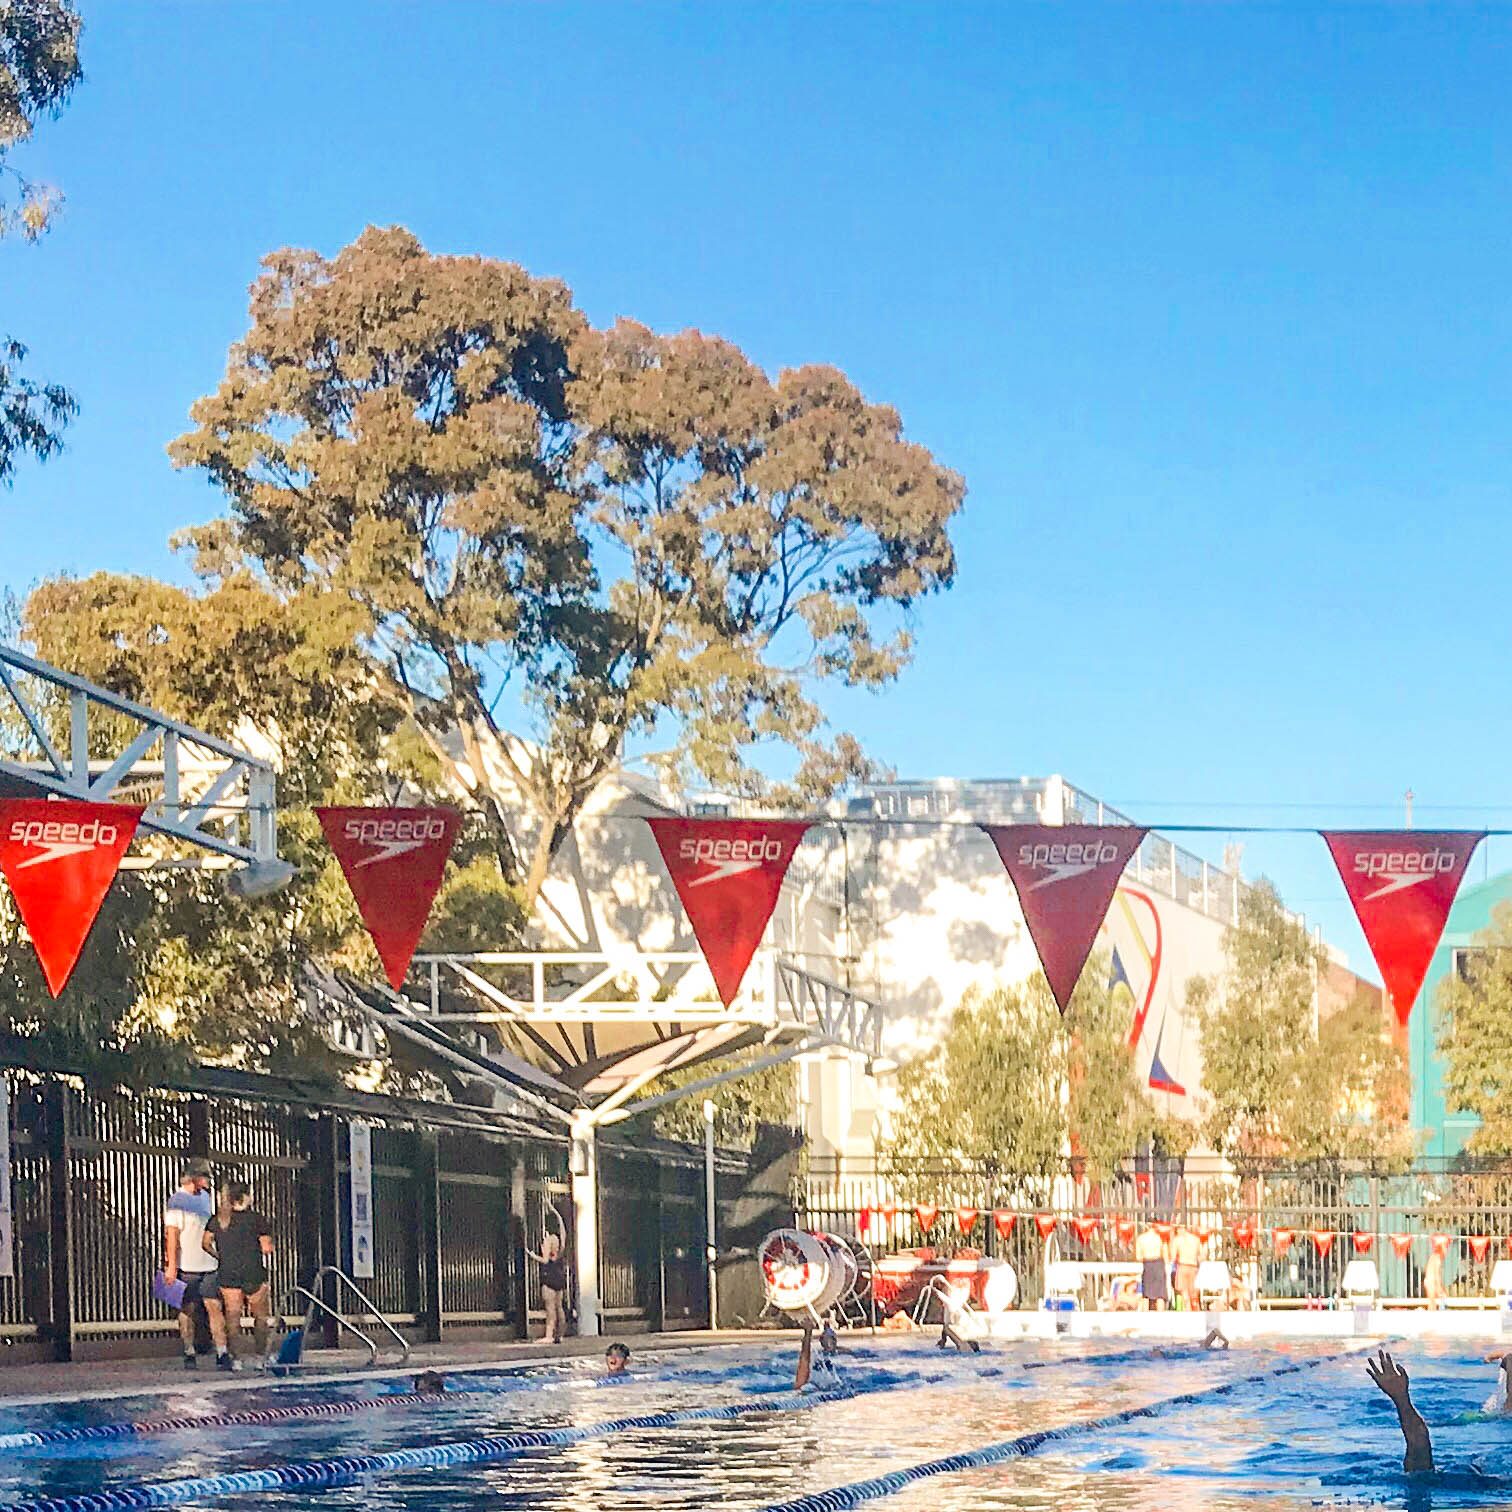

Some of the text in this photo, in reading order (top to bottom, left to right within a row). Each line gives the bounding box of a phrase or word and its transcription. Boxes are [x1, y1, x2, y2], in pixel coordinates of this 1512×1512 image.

[9, 819, 117, 846] speedo
[345, 815, 444, 844] speedo
[680, 834, 781, 864] speedo
[1018, 840, 1118, 869] speedo
[1355, 848, 1455, 877] speedo
